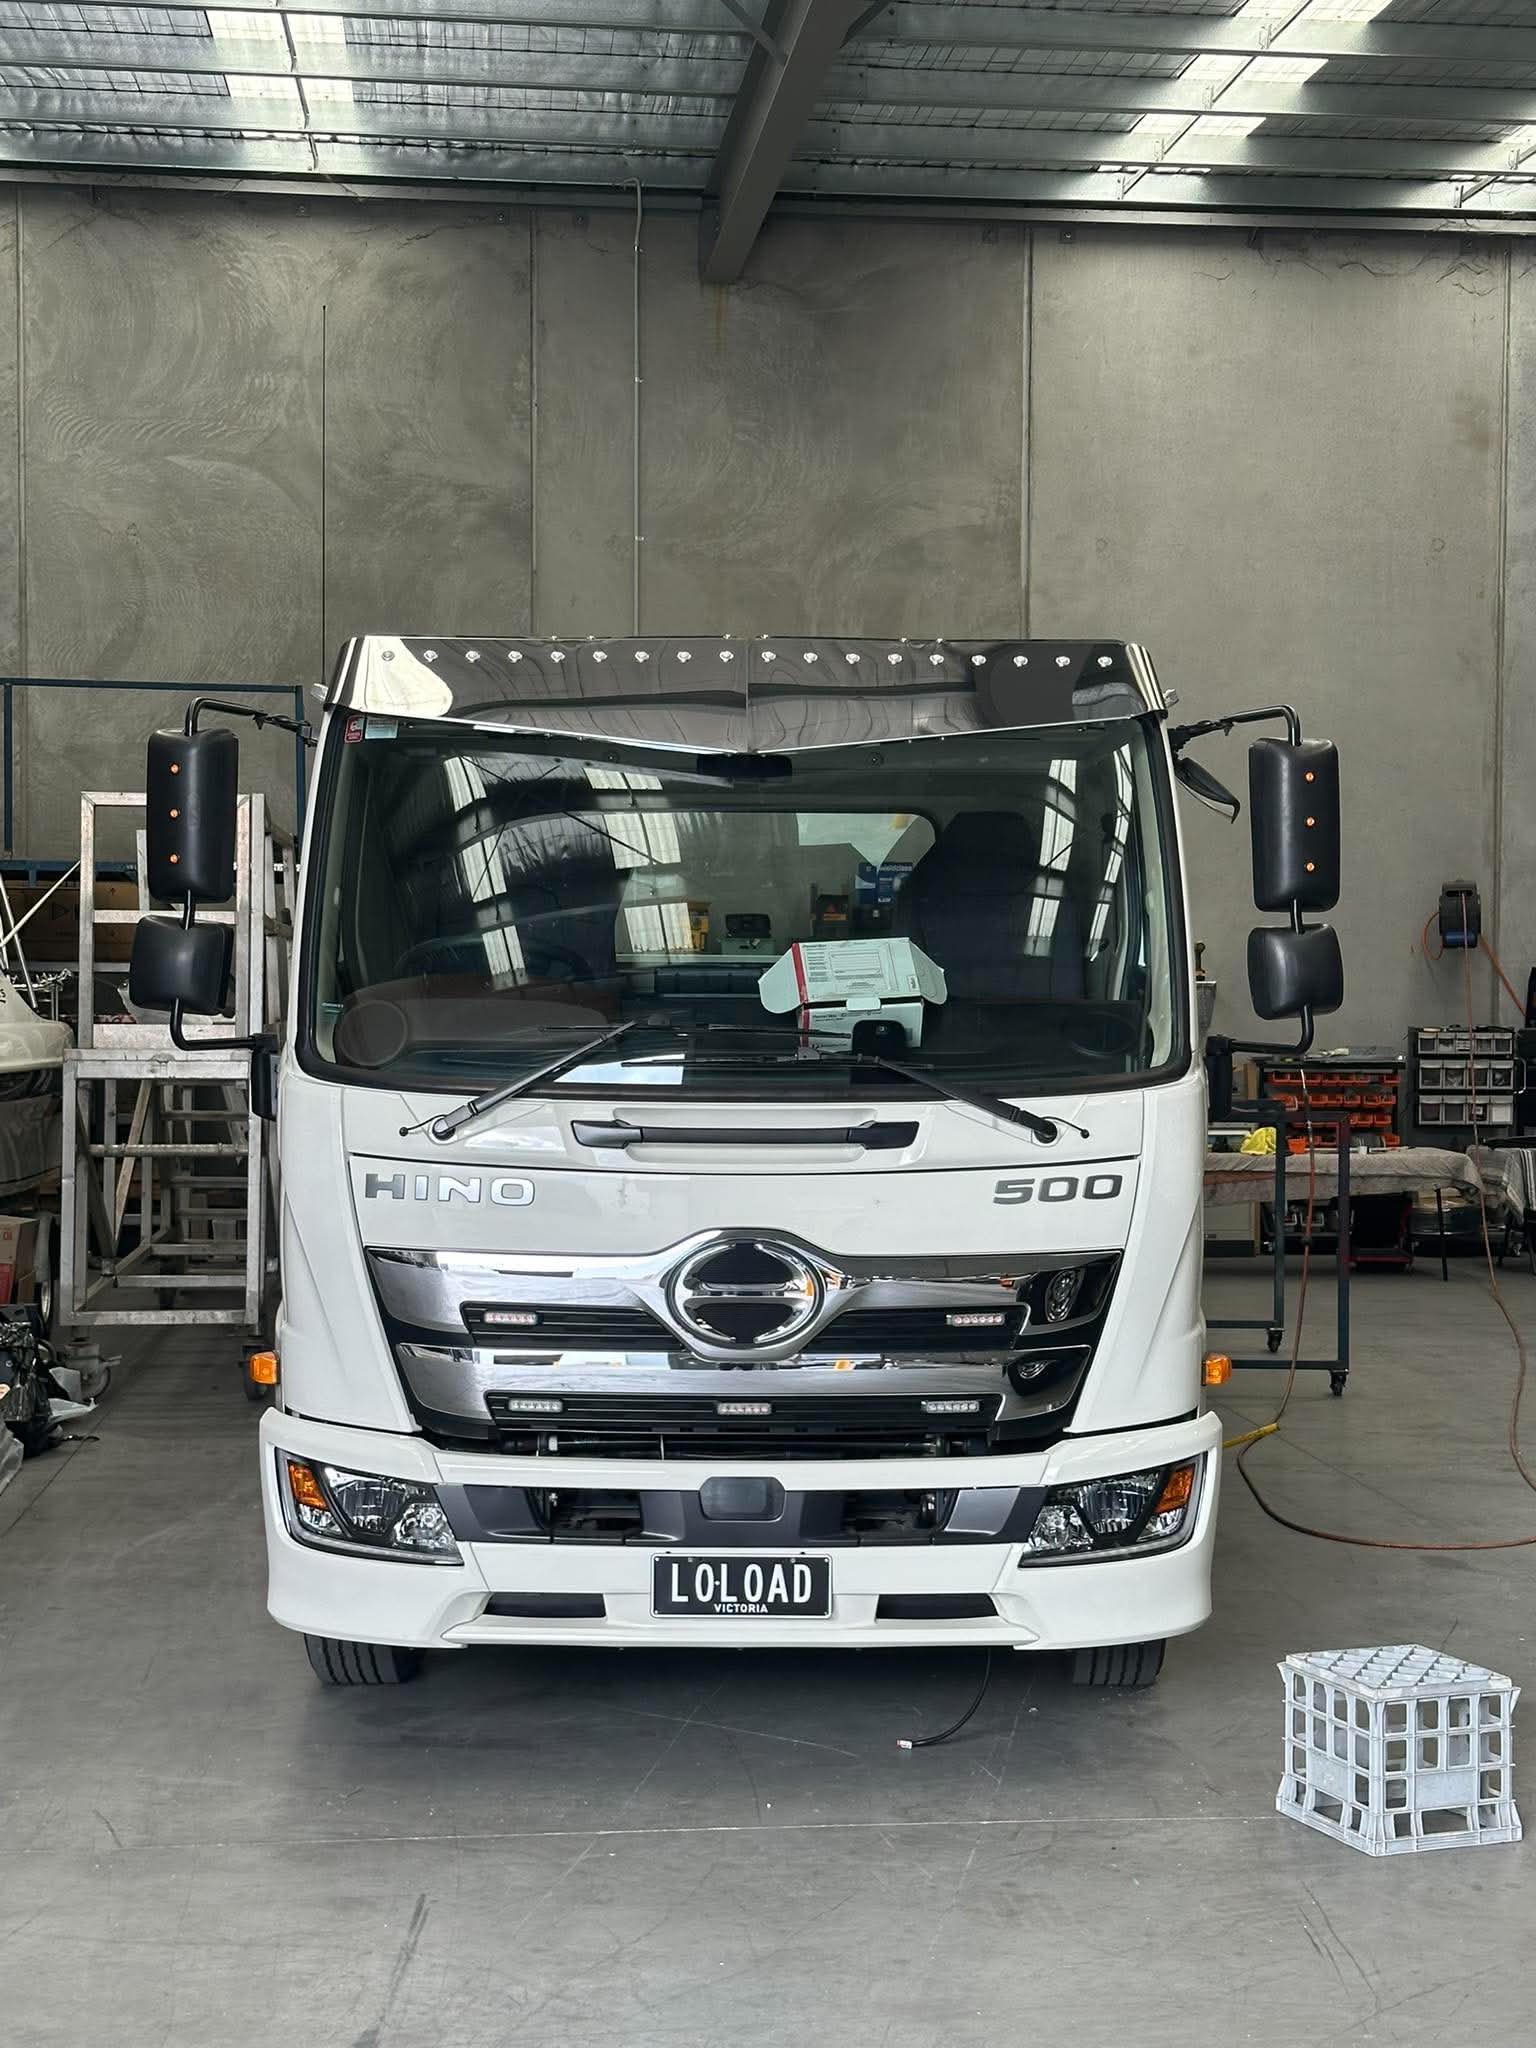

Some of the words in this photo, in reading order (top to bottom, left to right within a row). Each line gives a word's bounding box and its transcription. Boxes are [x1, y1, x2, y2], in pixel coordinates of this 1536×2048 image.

[365, 1173, 535, 1206] HINO
[993, 1174, 1123, 1205] 500
[713, 1603, 769, 1613] VICTORIA
